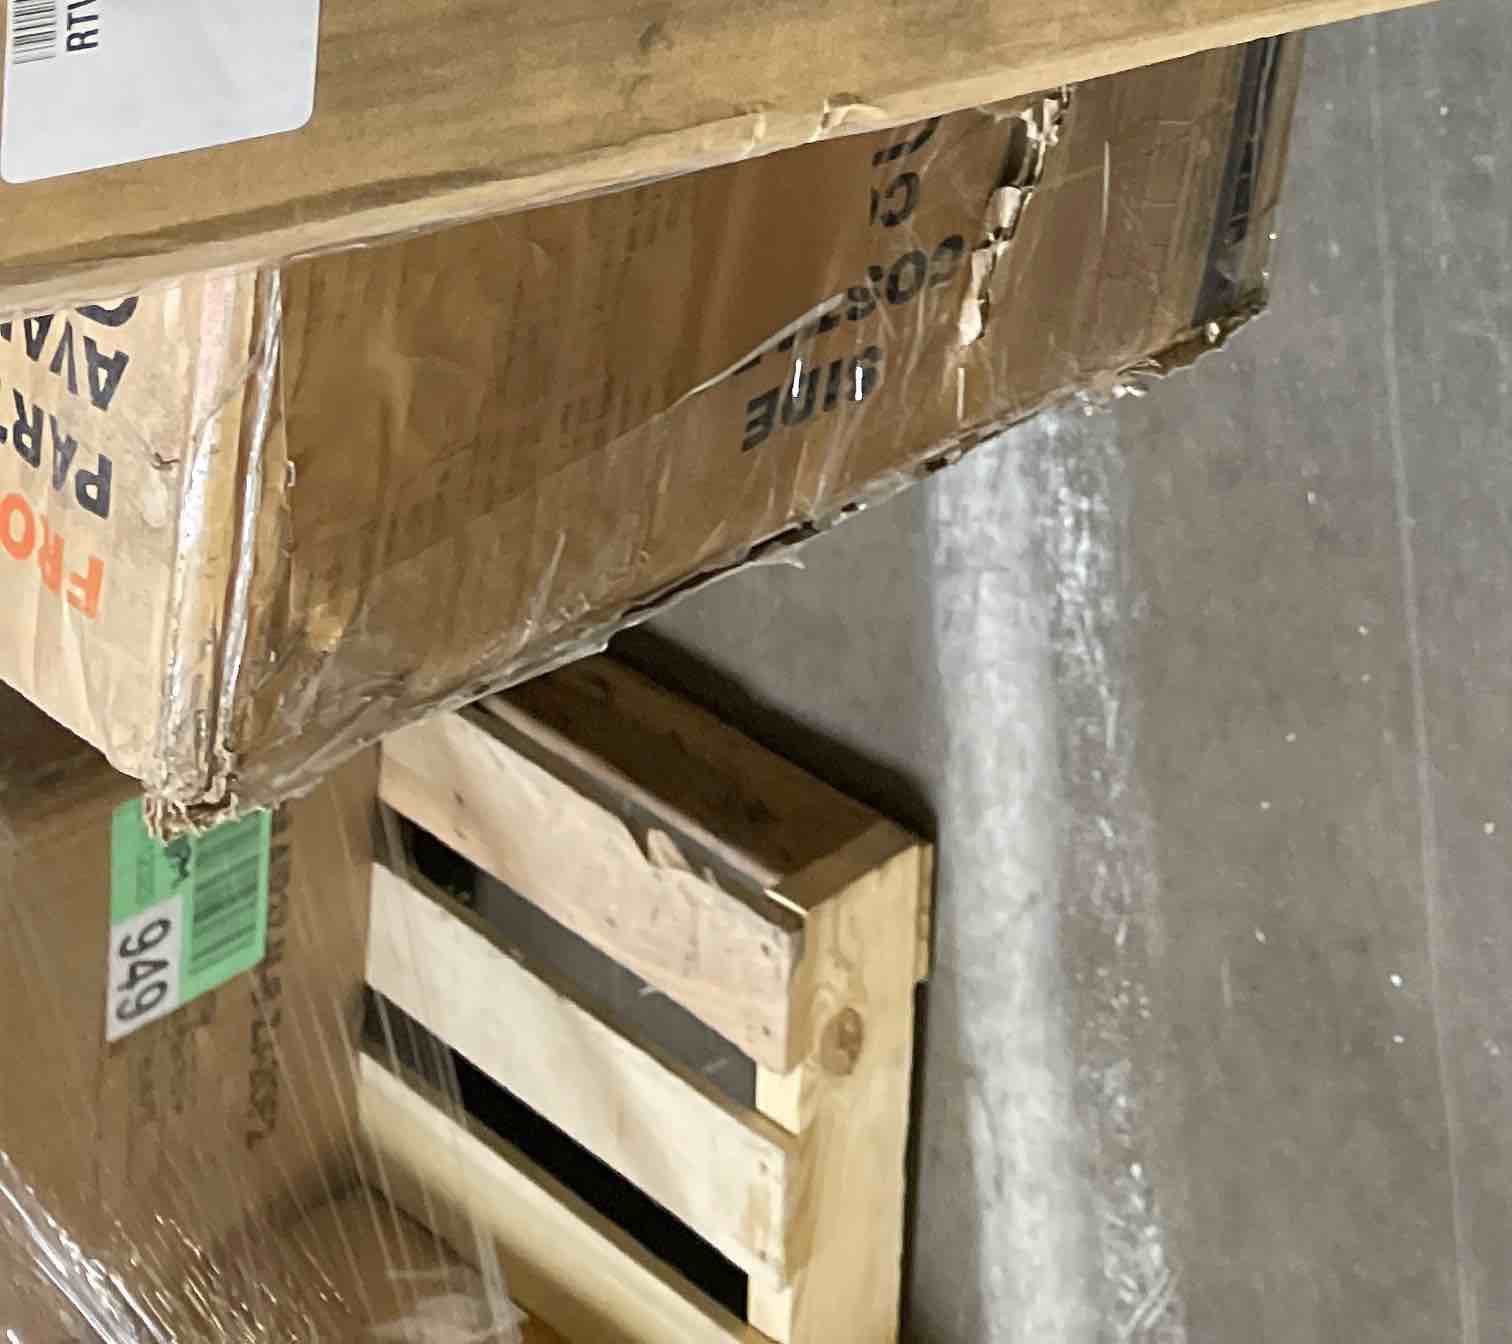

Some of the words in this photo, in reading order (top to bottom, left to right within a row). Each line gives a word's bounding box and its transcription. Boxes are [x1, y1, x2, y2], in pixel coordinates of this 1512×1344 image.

[0, 313, 131, 412] AVA
[0, 387, 113, 520] PAR
[116, 919, 170, 1023] 949
